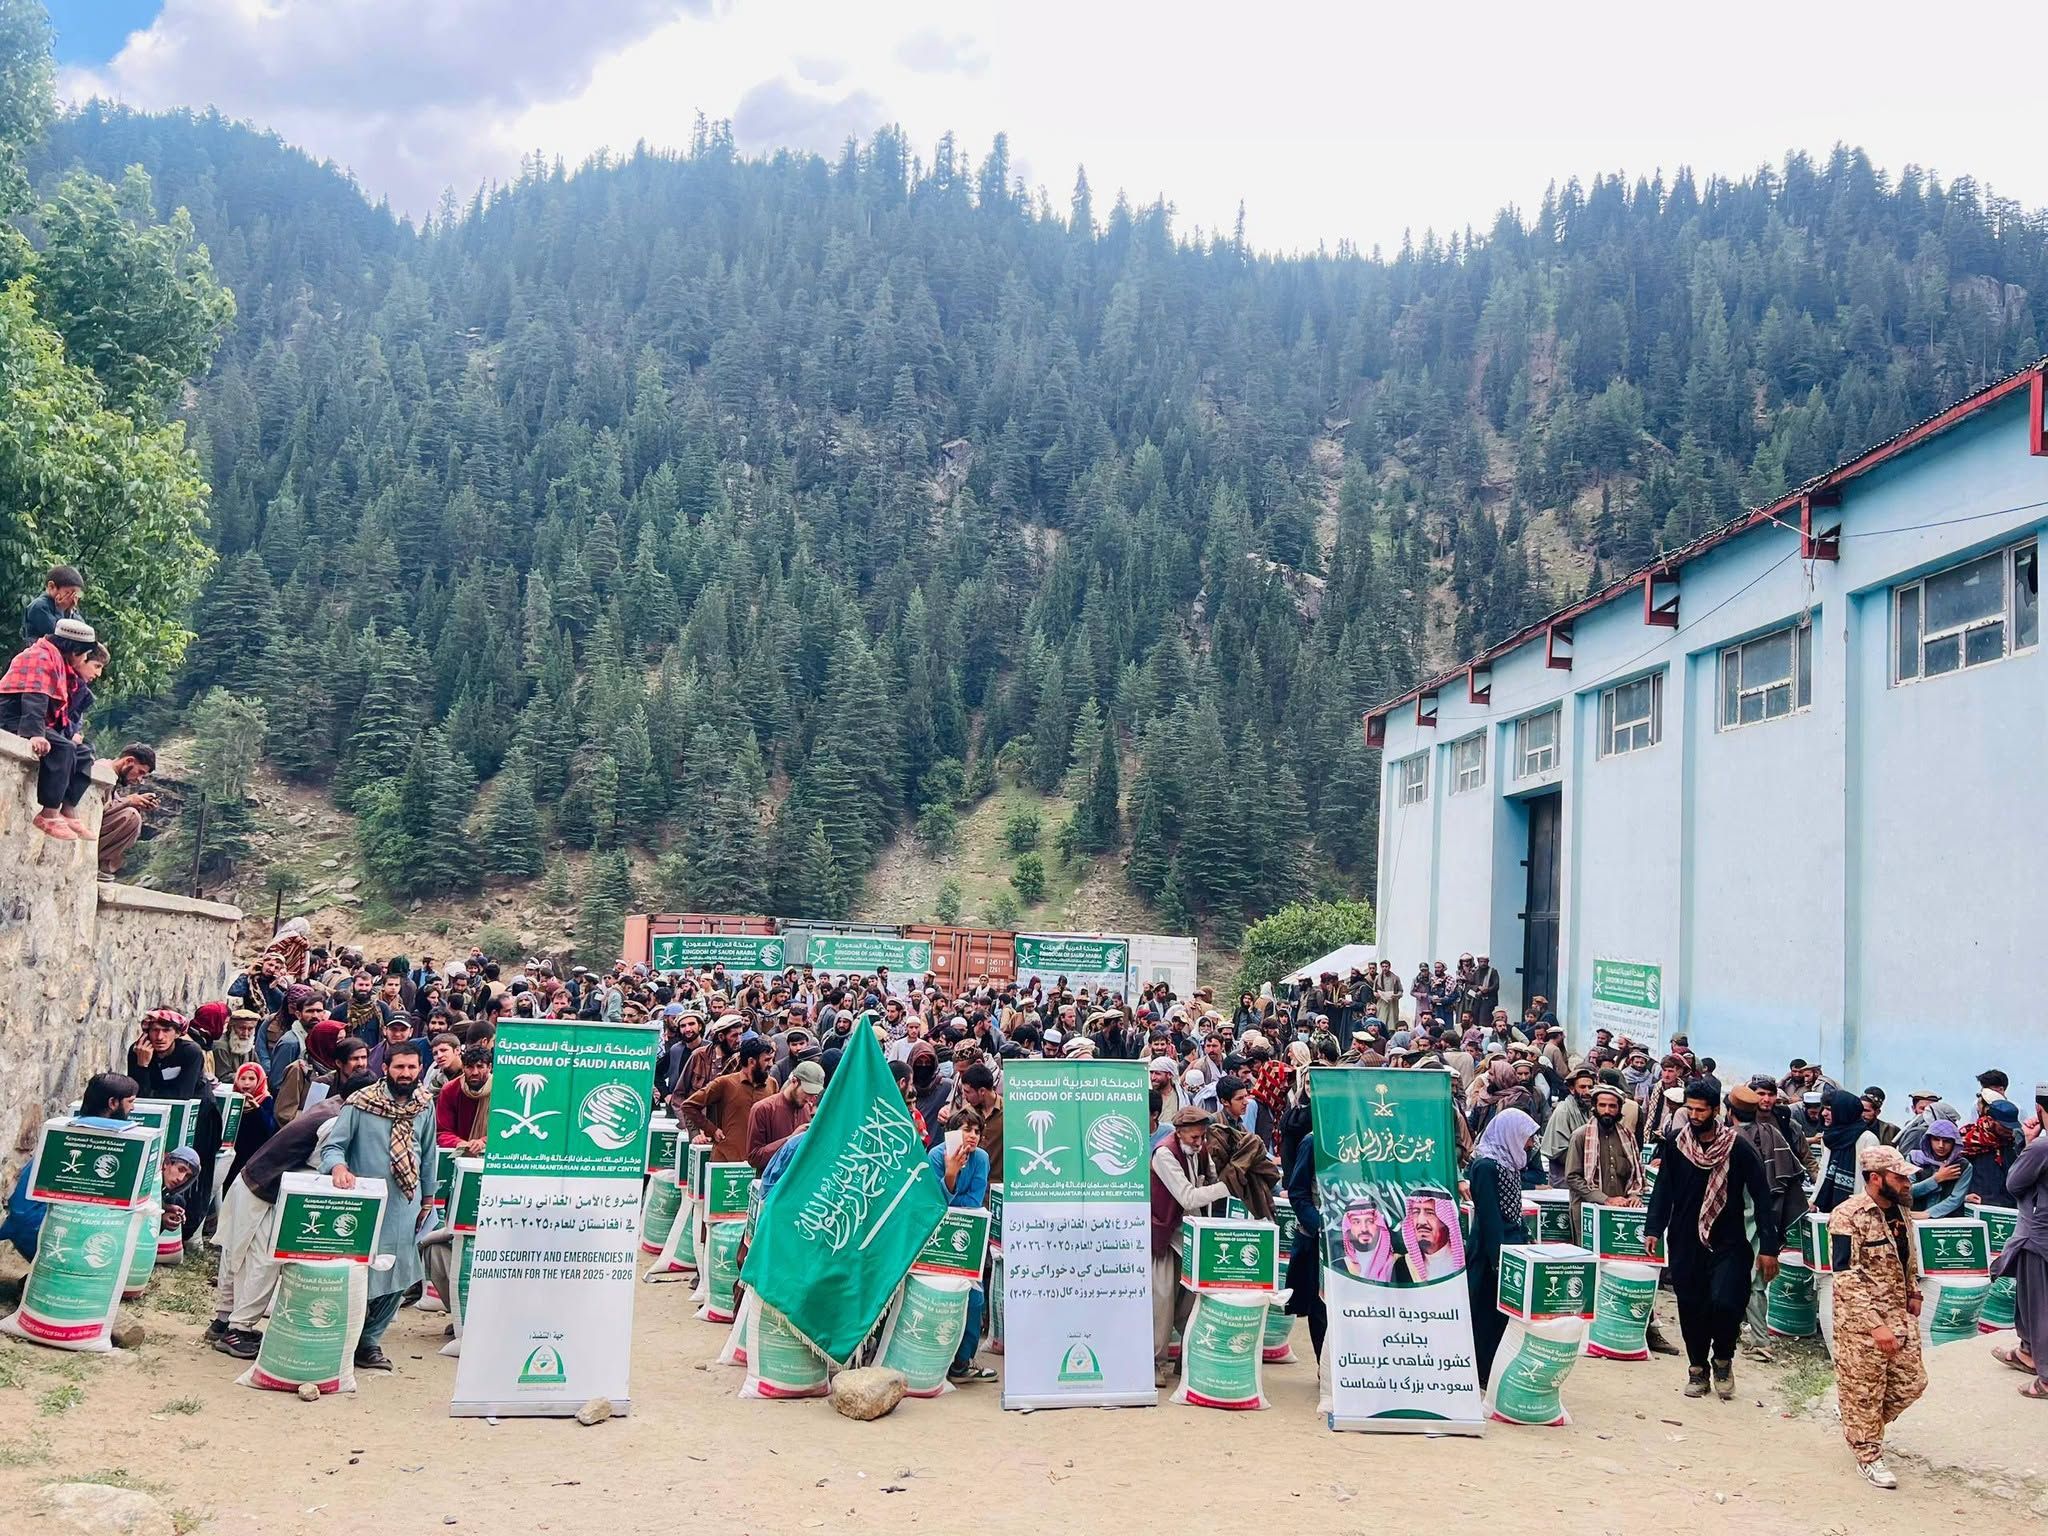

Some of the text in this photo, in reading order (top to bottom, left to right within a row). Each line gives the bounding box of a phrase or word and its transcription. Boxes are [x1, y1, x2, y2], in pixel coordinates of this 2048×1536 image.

[498, 1038, 651, 1057] المملكة العربية السعودية
[497, 1055, 651, 1070] KINGDOM OF SAUDI ARABIA
[1009, 1076, 1143, 1090] المملكة العربية السعودية
[1009, 1091, 1143, 1102] KINGDOM OF SAUDI ARABIA
[530, 1163, 578, 1171] HUMANITARIAN
[604, 1193, 639, 1208] مشروع
[625, 1217, 635, 1232] في
[1115, 1216, 1145, 1230] مشروع
[1135, 1239, 1145, 1252] في
[475, 1249, 634, 1263] FOOD SECURITY AND EMERGENCIES IN
[472, 1268, 523, 1279] AGHANISTAN
[524, 1268, 540, 1279] FOR
[543, 1269, 557, 1279] THE
[560, 1269, 581, 1279] YEAR
[583, 1269, 604, 1279] 2025
[611, 1269, 632, 1280] 2026
[1069, 1266, 1075, 1274] د
[1138, 1286, 1146, 1298] او
[1342, 1306, 1459, 1323] السعودية العظمى
[1382, 1332, 1429, 1348] بجانبكم
[1338, 1352, 1389, 1369] عربستان
[1340, 1376, 1386, 1389] شماست
[1389, 1379, 1397, 1392] با
[1400, 1377, 1425, 1395] بزرگ
